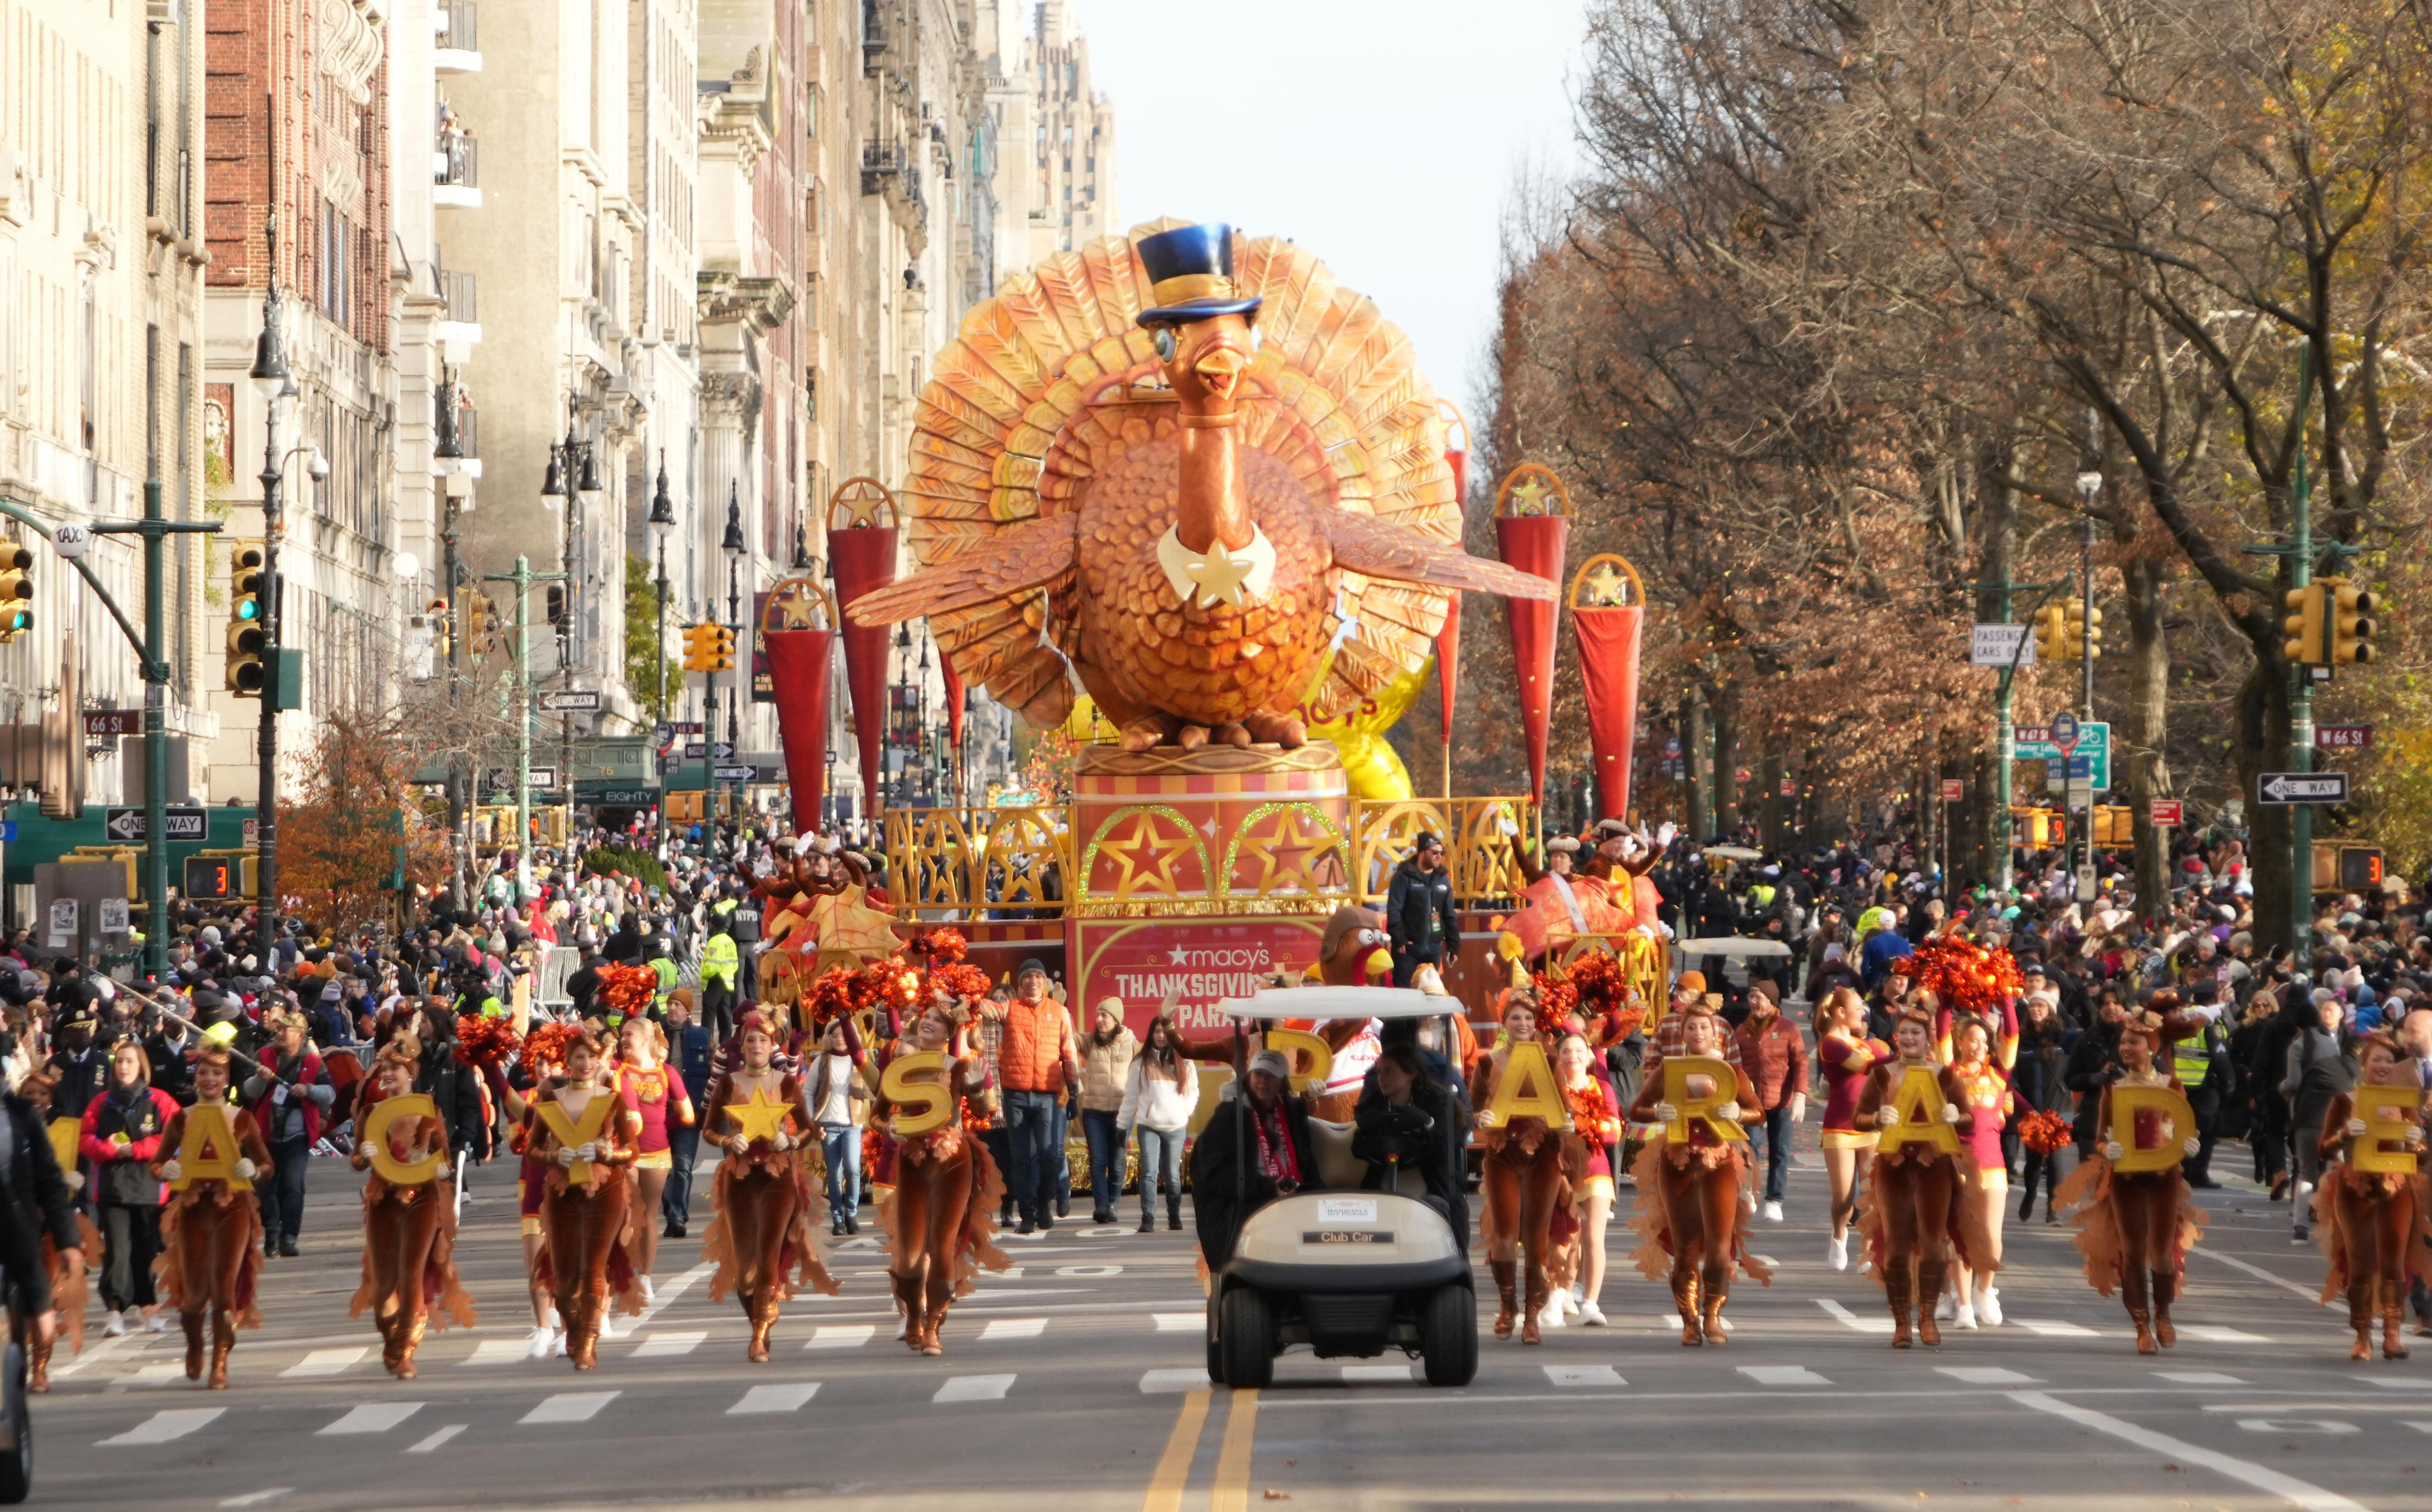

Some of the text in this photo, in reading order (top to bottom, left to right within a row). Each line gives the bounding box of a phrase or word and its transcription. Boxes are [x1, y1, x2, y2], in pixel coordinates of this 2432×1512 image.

[1977, 630, 2025, 642] PASSENGE
[573, 695, 591, 704] WAY
[91, 717, 123, 732] 66 St
[2321, 730, 2363, 745] W 66 St
[600, 766, 614, 775] 75
[2274, 783, 2335, 794] ONE WAY
[120, 817, 197, 831] ONE WAY
[2369, 855, 2381, 882] 3
[216, 866, 227, 894] 3
[735, 909, 758, 921] NYPD
[1115, 973, 1257, 998] THANKSGIVIN
[1179, 1004, 1253, 1028] PARAD
[1322, 1232, 1373, 1242] Club Car
